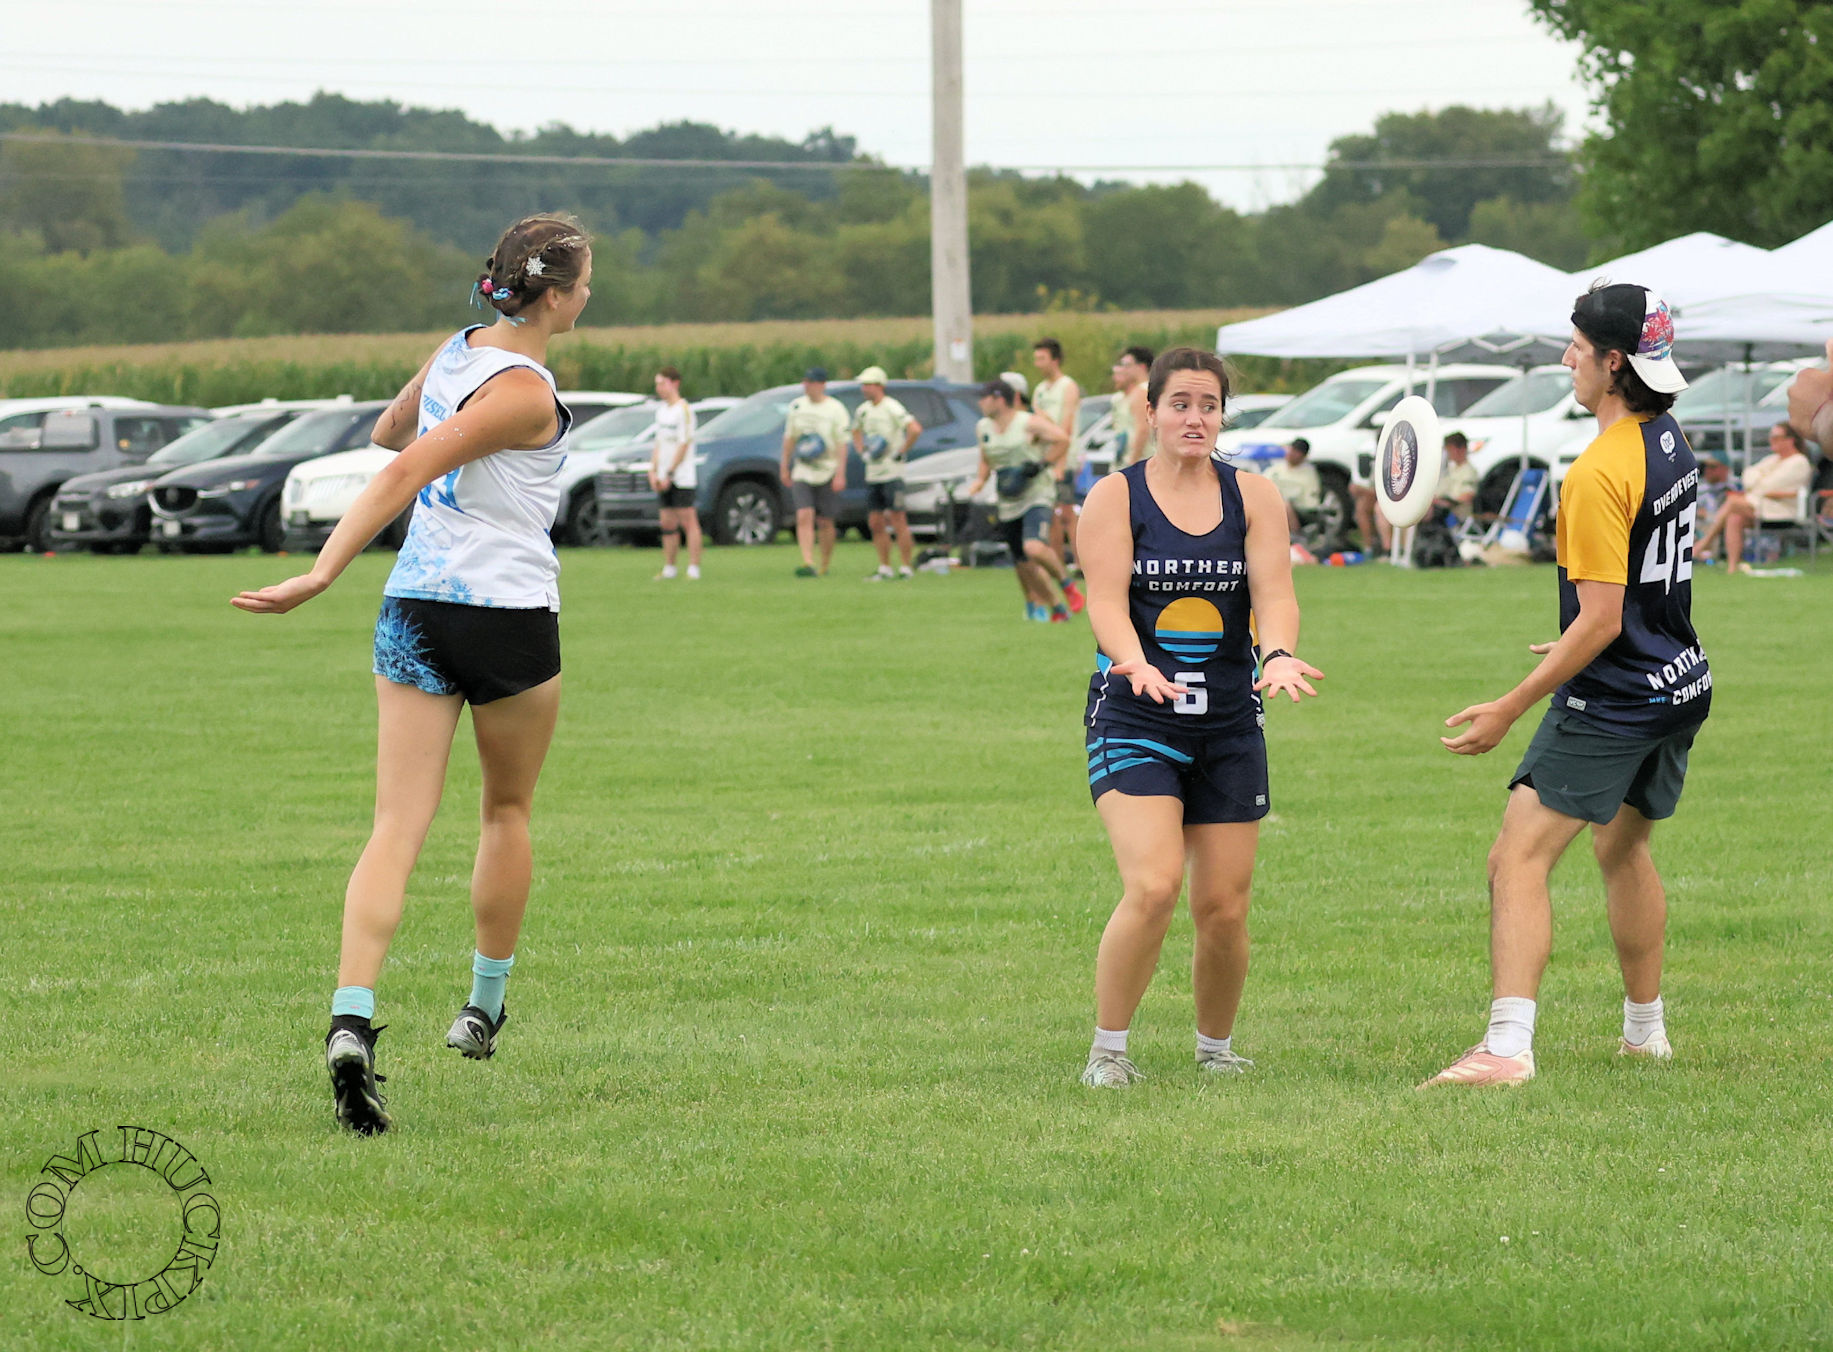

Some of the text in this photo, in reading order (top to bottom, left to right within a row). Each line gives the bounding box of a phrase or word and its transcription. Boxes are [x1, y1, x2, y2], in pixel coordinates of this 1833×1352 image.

[1640, 501, 1697, 595] 42
[1132, 559, 1247, 575] NORTHER
[1148, 580, 1239, 592] COMFORT
[1173, 671, 1208, 715] 6
